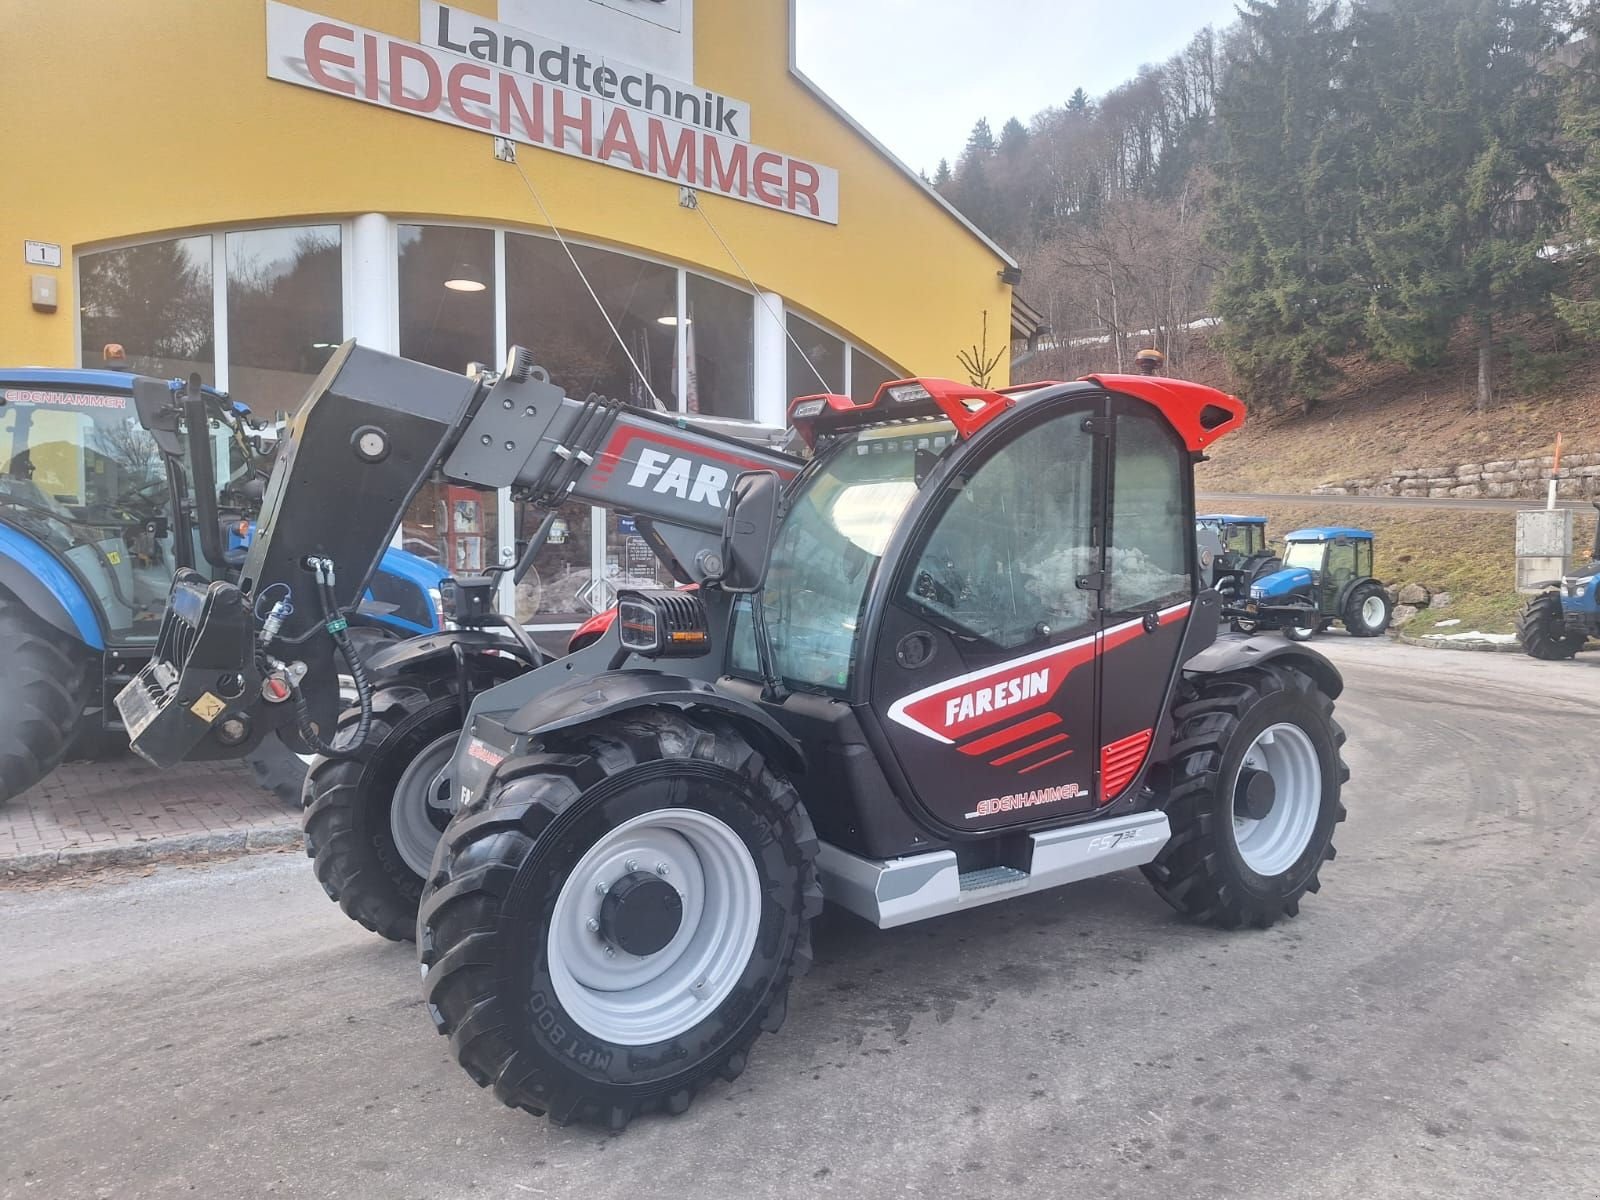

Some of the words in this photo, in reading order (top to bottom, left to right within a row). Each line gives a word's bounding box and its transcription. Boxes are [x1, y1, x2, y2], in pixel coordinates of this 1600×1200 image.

[437, 5, 739, 137] Landtechnik
[303, 21, 820, 216] EIDENHAMMER
[40, 247, 45, 260] 1
[5, 390, 126, 409] EIDENHAMMER
[627, 447, 734, 513] FAR
[944, 668, 1050, 727] FARESIN
[976, 783, 1080, 816] EIDENHAMMER
[530, 993, 566, 1044] 800
